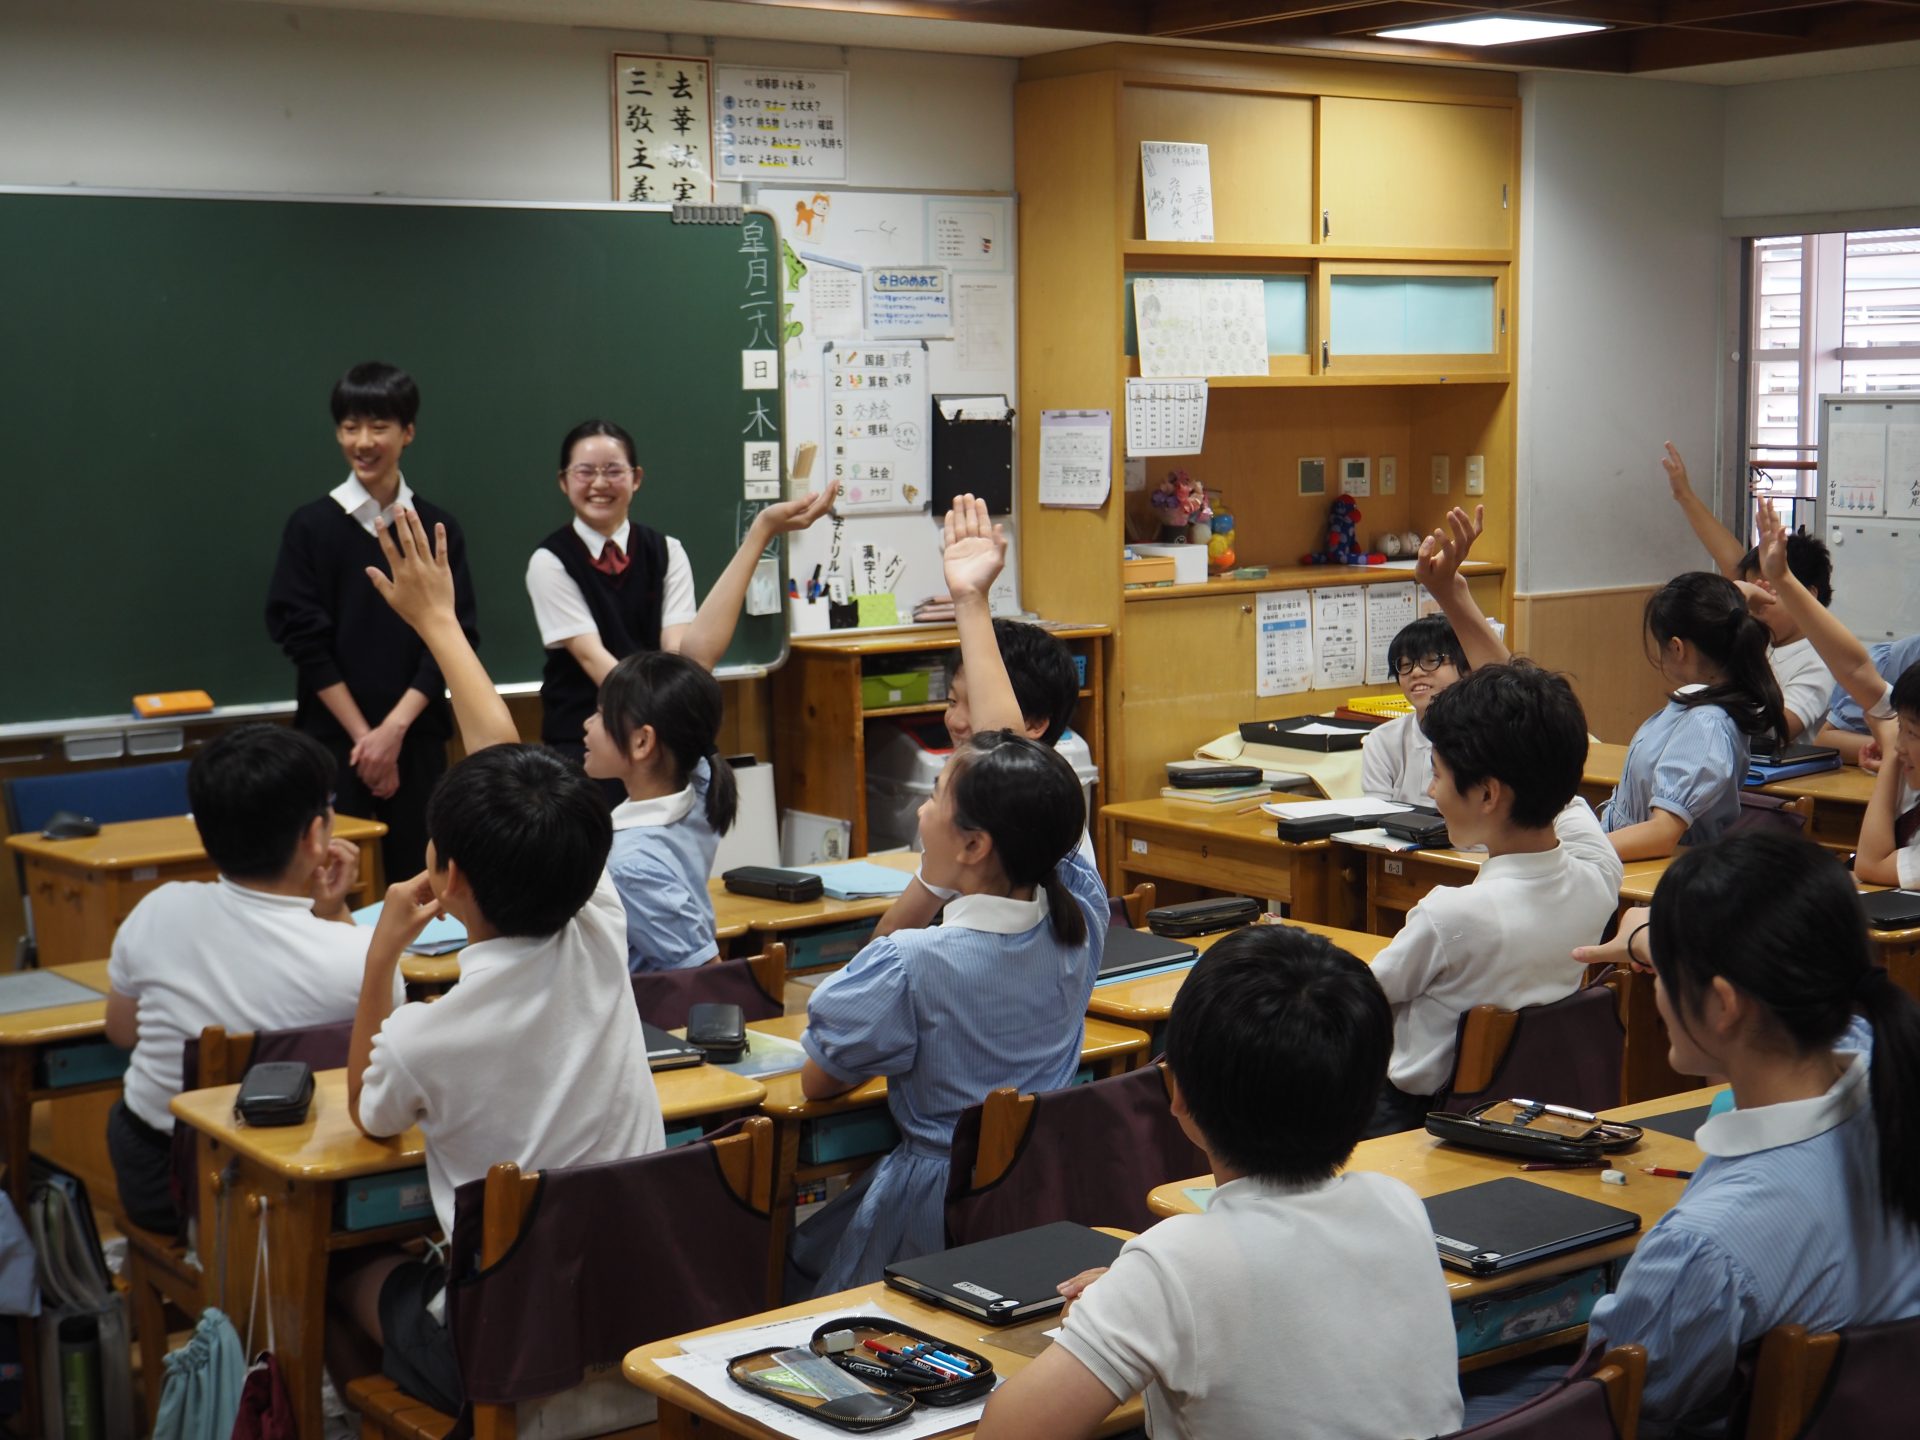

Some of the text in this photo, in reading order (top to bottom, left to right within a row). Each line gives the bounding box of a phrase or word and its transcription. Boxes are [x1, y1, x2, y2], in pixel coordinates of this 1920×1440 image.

[625, 71, 655, 203] 三敬主義
[879, 274, 938, 288] 今日のめあて
[835, 353, 841, 365] 1
[864, 354, 885, 367] 国語
[835, 375, 843, 387] 2
[868, 376, 889, 388] 算数
[835, 404, 843, 416] 3
[835, 424, 888, 437] 4 理科
[835, 465, 890, 479] 5 社会
[836, 486, 845, 497] 6
